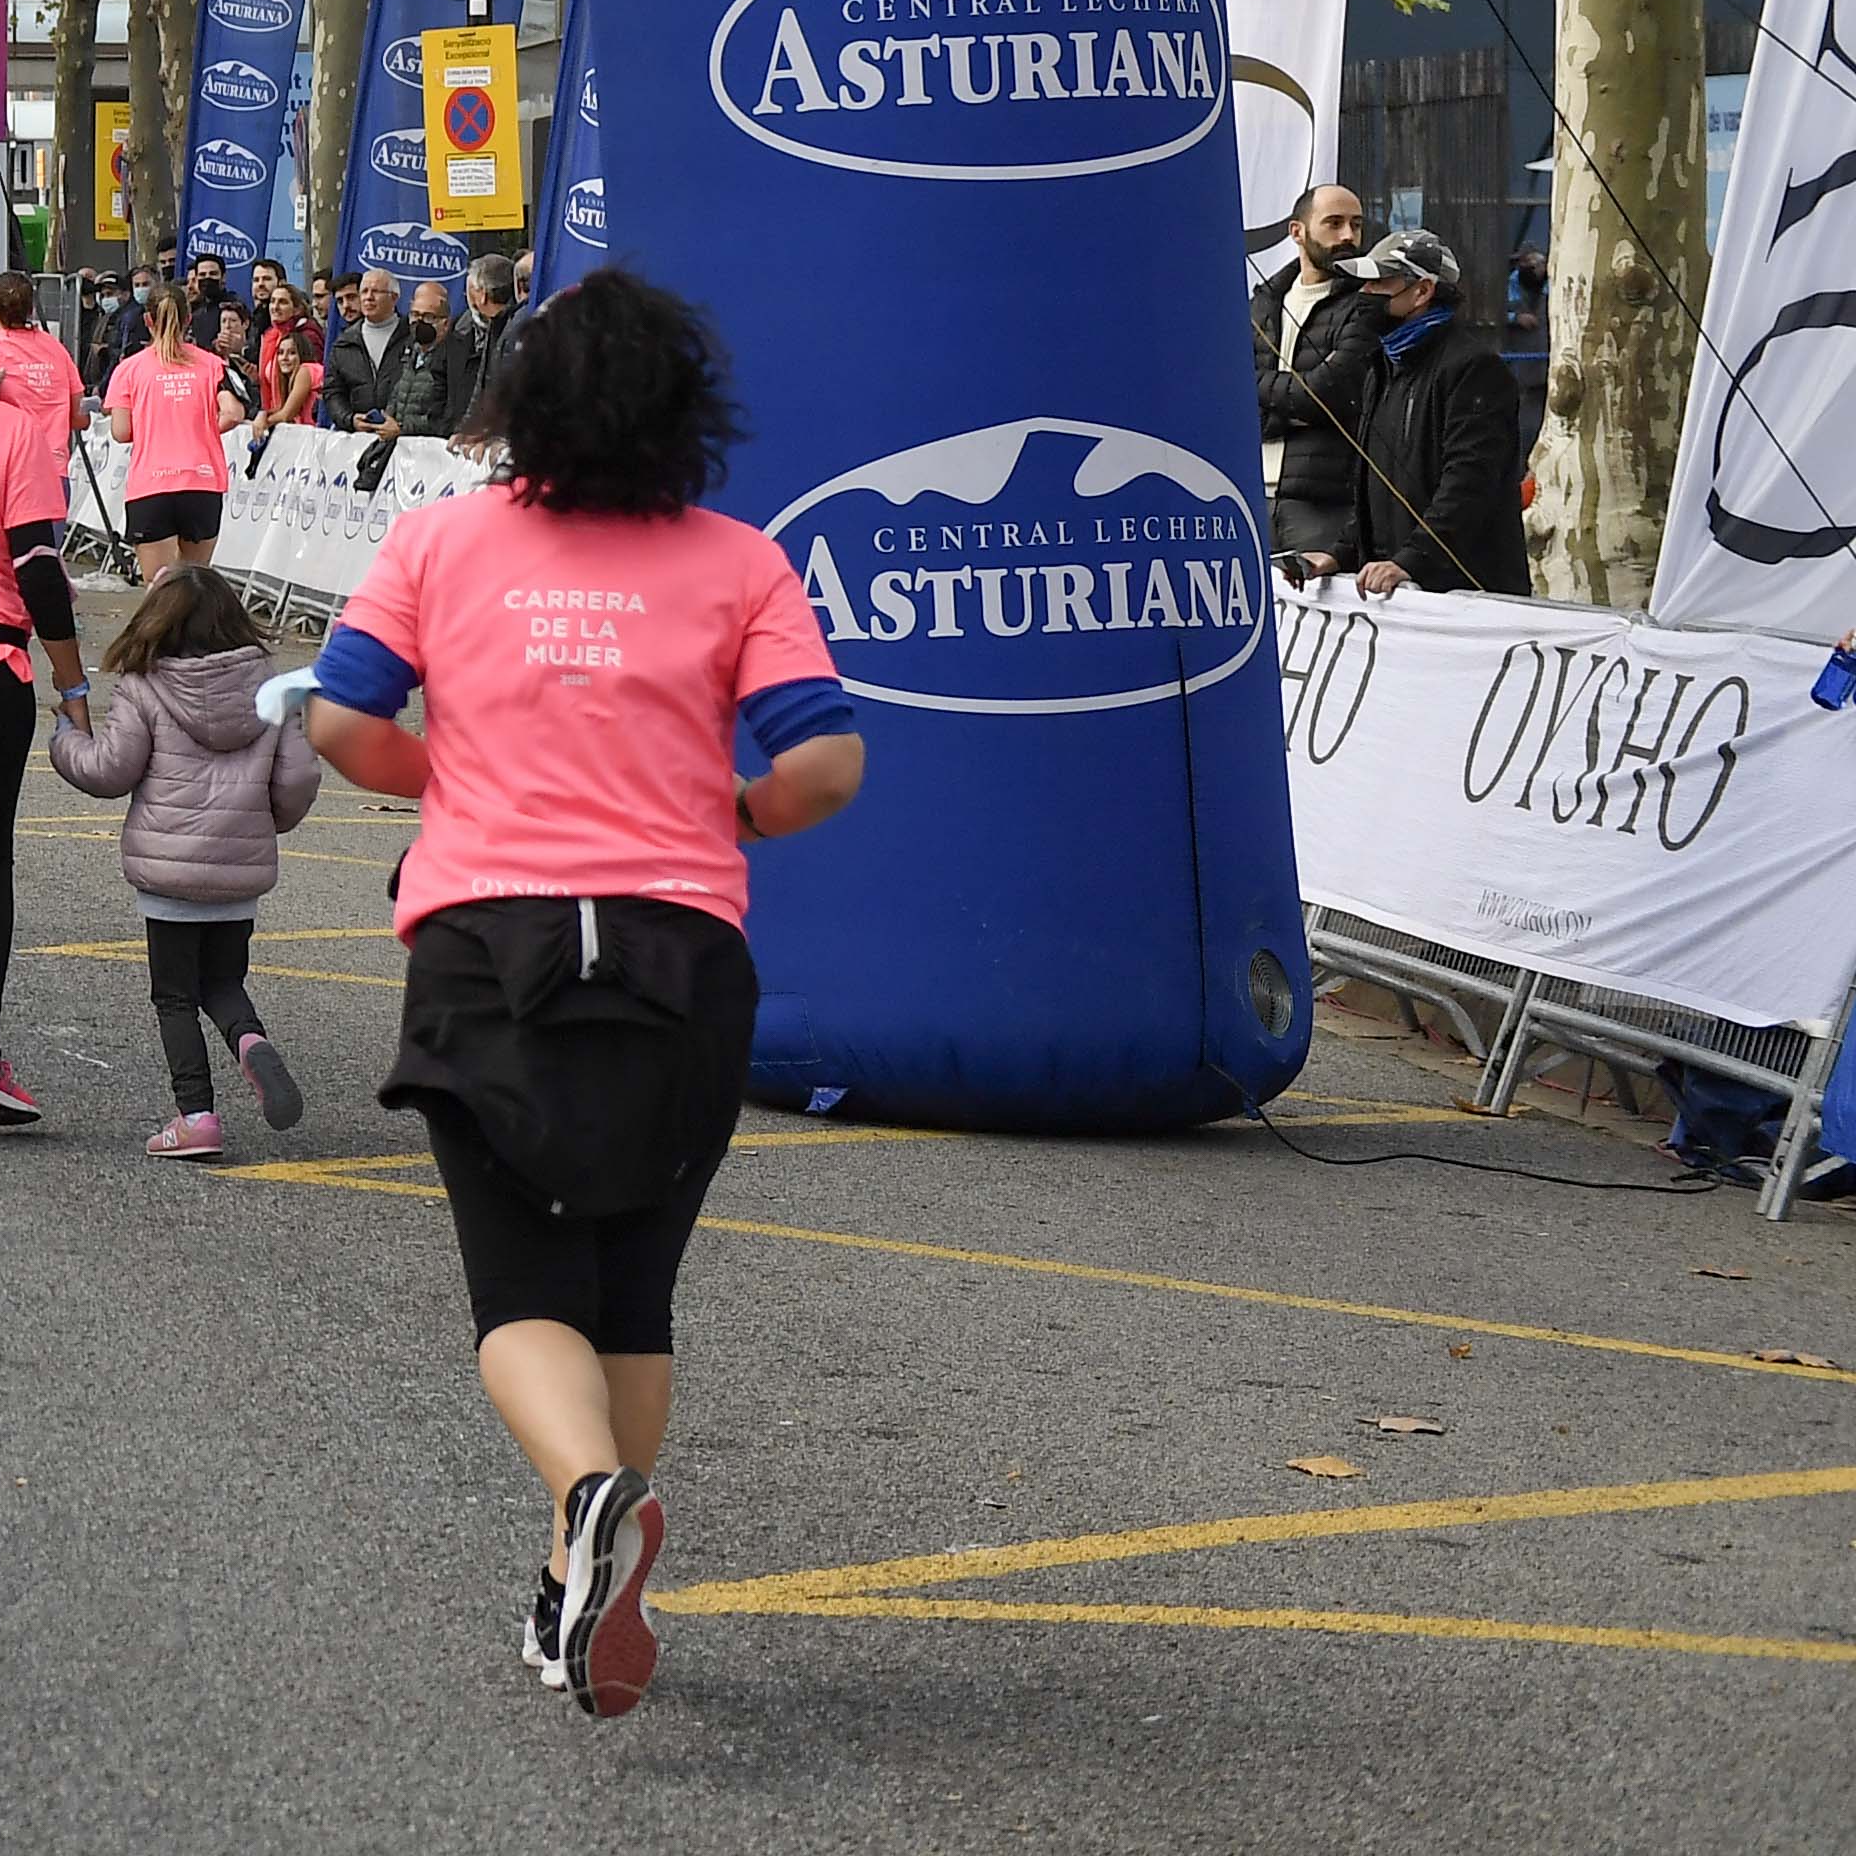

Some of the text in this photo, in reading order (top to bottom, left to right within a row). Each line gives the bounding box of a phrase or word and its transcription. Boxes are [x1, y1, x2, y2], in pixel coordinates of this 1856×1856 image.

[752, 6, 1215, 116] ASTURIANA
[360, 237, 462, 272] ASTURIANA
[872, 514, 1239, 554] CENTRAL LECHERA
[503, 589, 647, 615] CARRERA
[803, 534, 1255, 644] ASTURIANA
[530, 616, 619, 641] DE LA
[523, 644, 623, 667] MUJER
[1463, 640, 1751, 852] OYSHO
